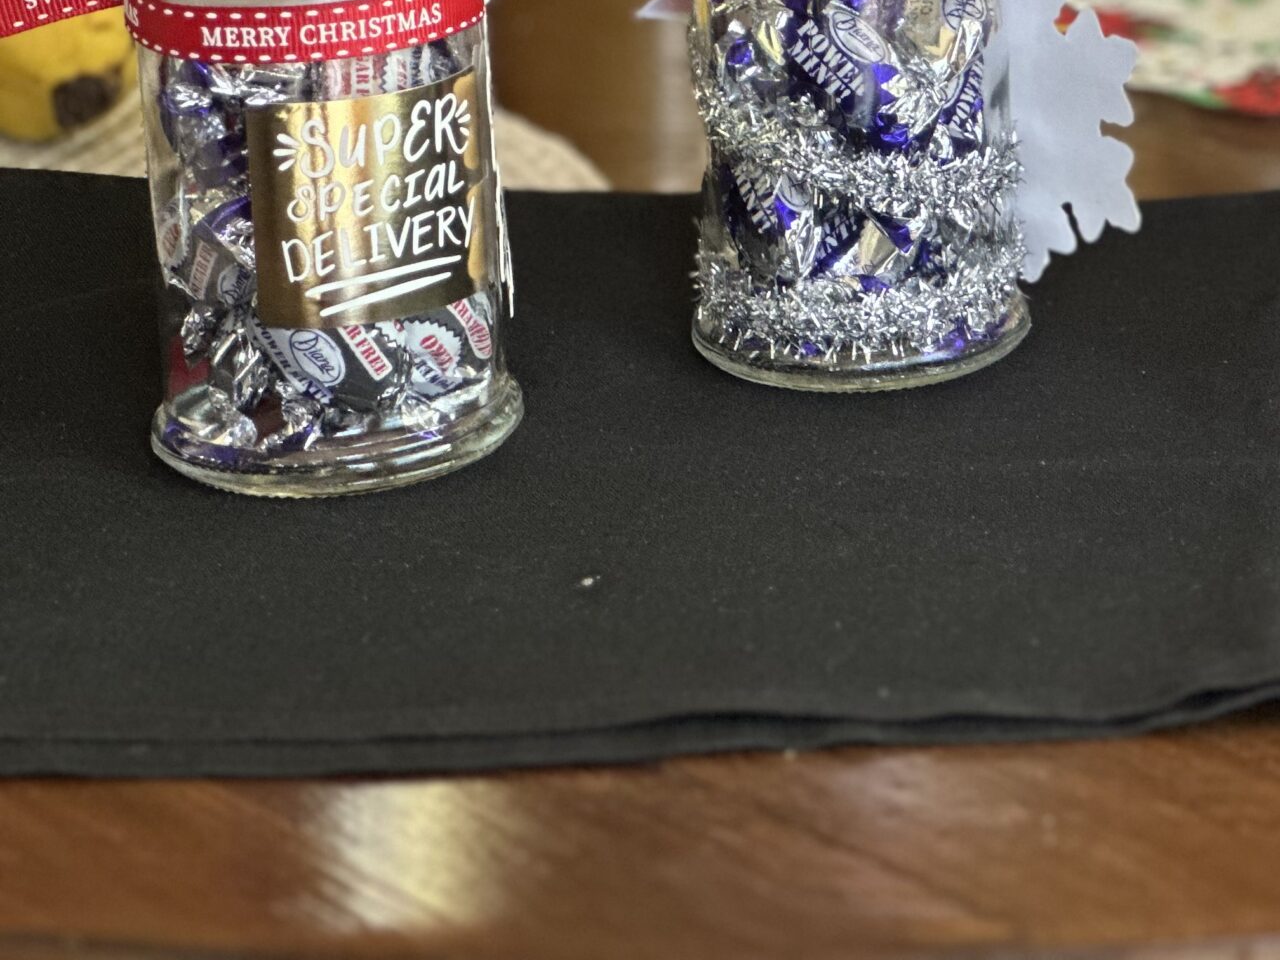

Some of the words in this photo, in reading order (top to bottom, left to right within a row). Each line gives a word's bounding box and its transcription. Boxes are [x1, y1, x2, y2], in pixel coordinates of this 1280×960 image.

[200, 25, 291, 47] MERRY
[299, 3, 442, 46] CHRISTMAS
[787, 39, 852, 103] MINT!
[797, 19, 866, 97] POWER
[281, 195, 475, 284] DELIVERY
[293, 333, 337, 376] Diana
[355, 337, 388, 376] FREE
